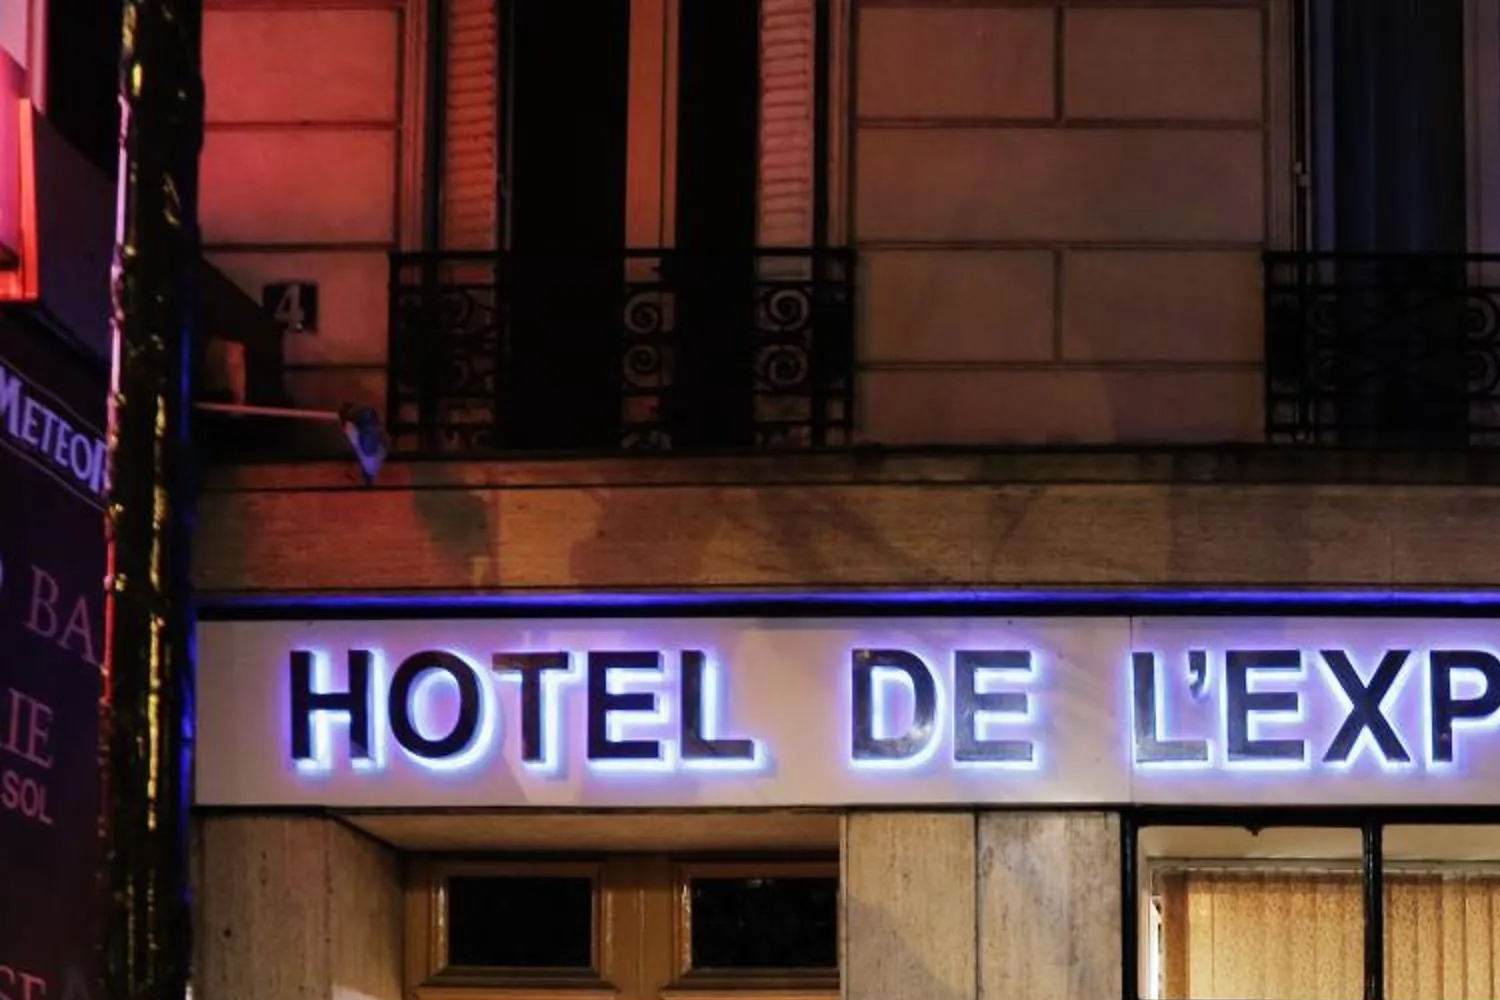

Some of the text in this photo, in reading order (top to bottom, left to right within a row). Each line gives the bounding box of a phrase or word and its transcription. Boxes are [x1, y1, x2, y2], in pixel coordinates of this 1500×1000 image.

[273, 284, 305, 331] 4
[290, 648, 756, 762] HOTEL
[849, 648, 1035, 762] DE
[0, 769, 54, 825] SOL
